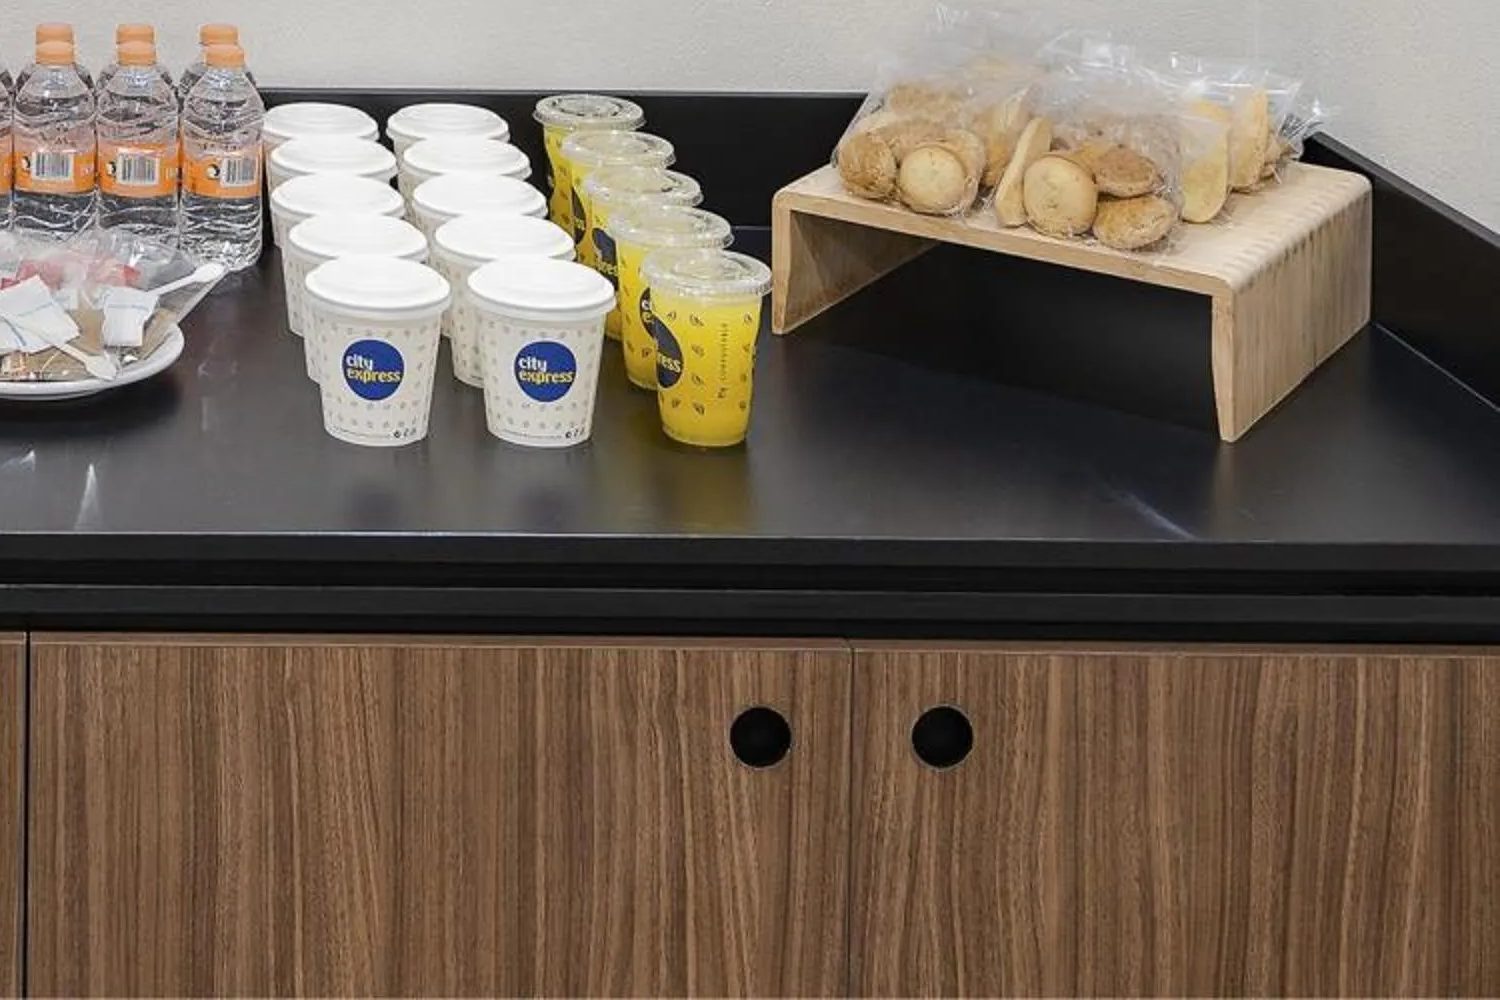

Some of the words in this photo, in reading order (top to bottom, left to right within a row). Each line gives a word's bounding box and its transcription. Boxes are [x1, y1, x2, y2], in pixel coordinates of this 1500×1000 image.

[346, 354, 373, 371] city
[519, 356, 547, 373] city
[658, 354, 681, 373] ress
[347, 368, 401, 384] express
[519, 371, 574, 385] express
